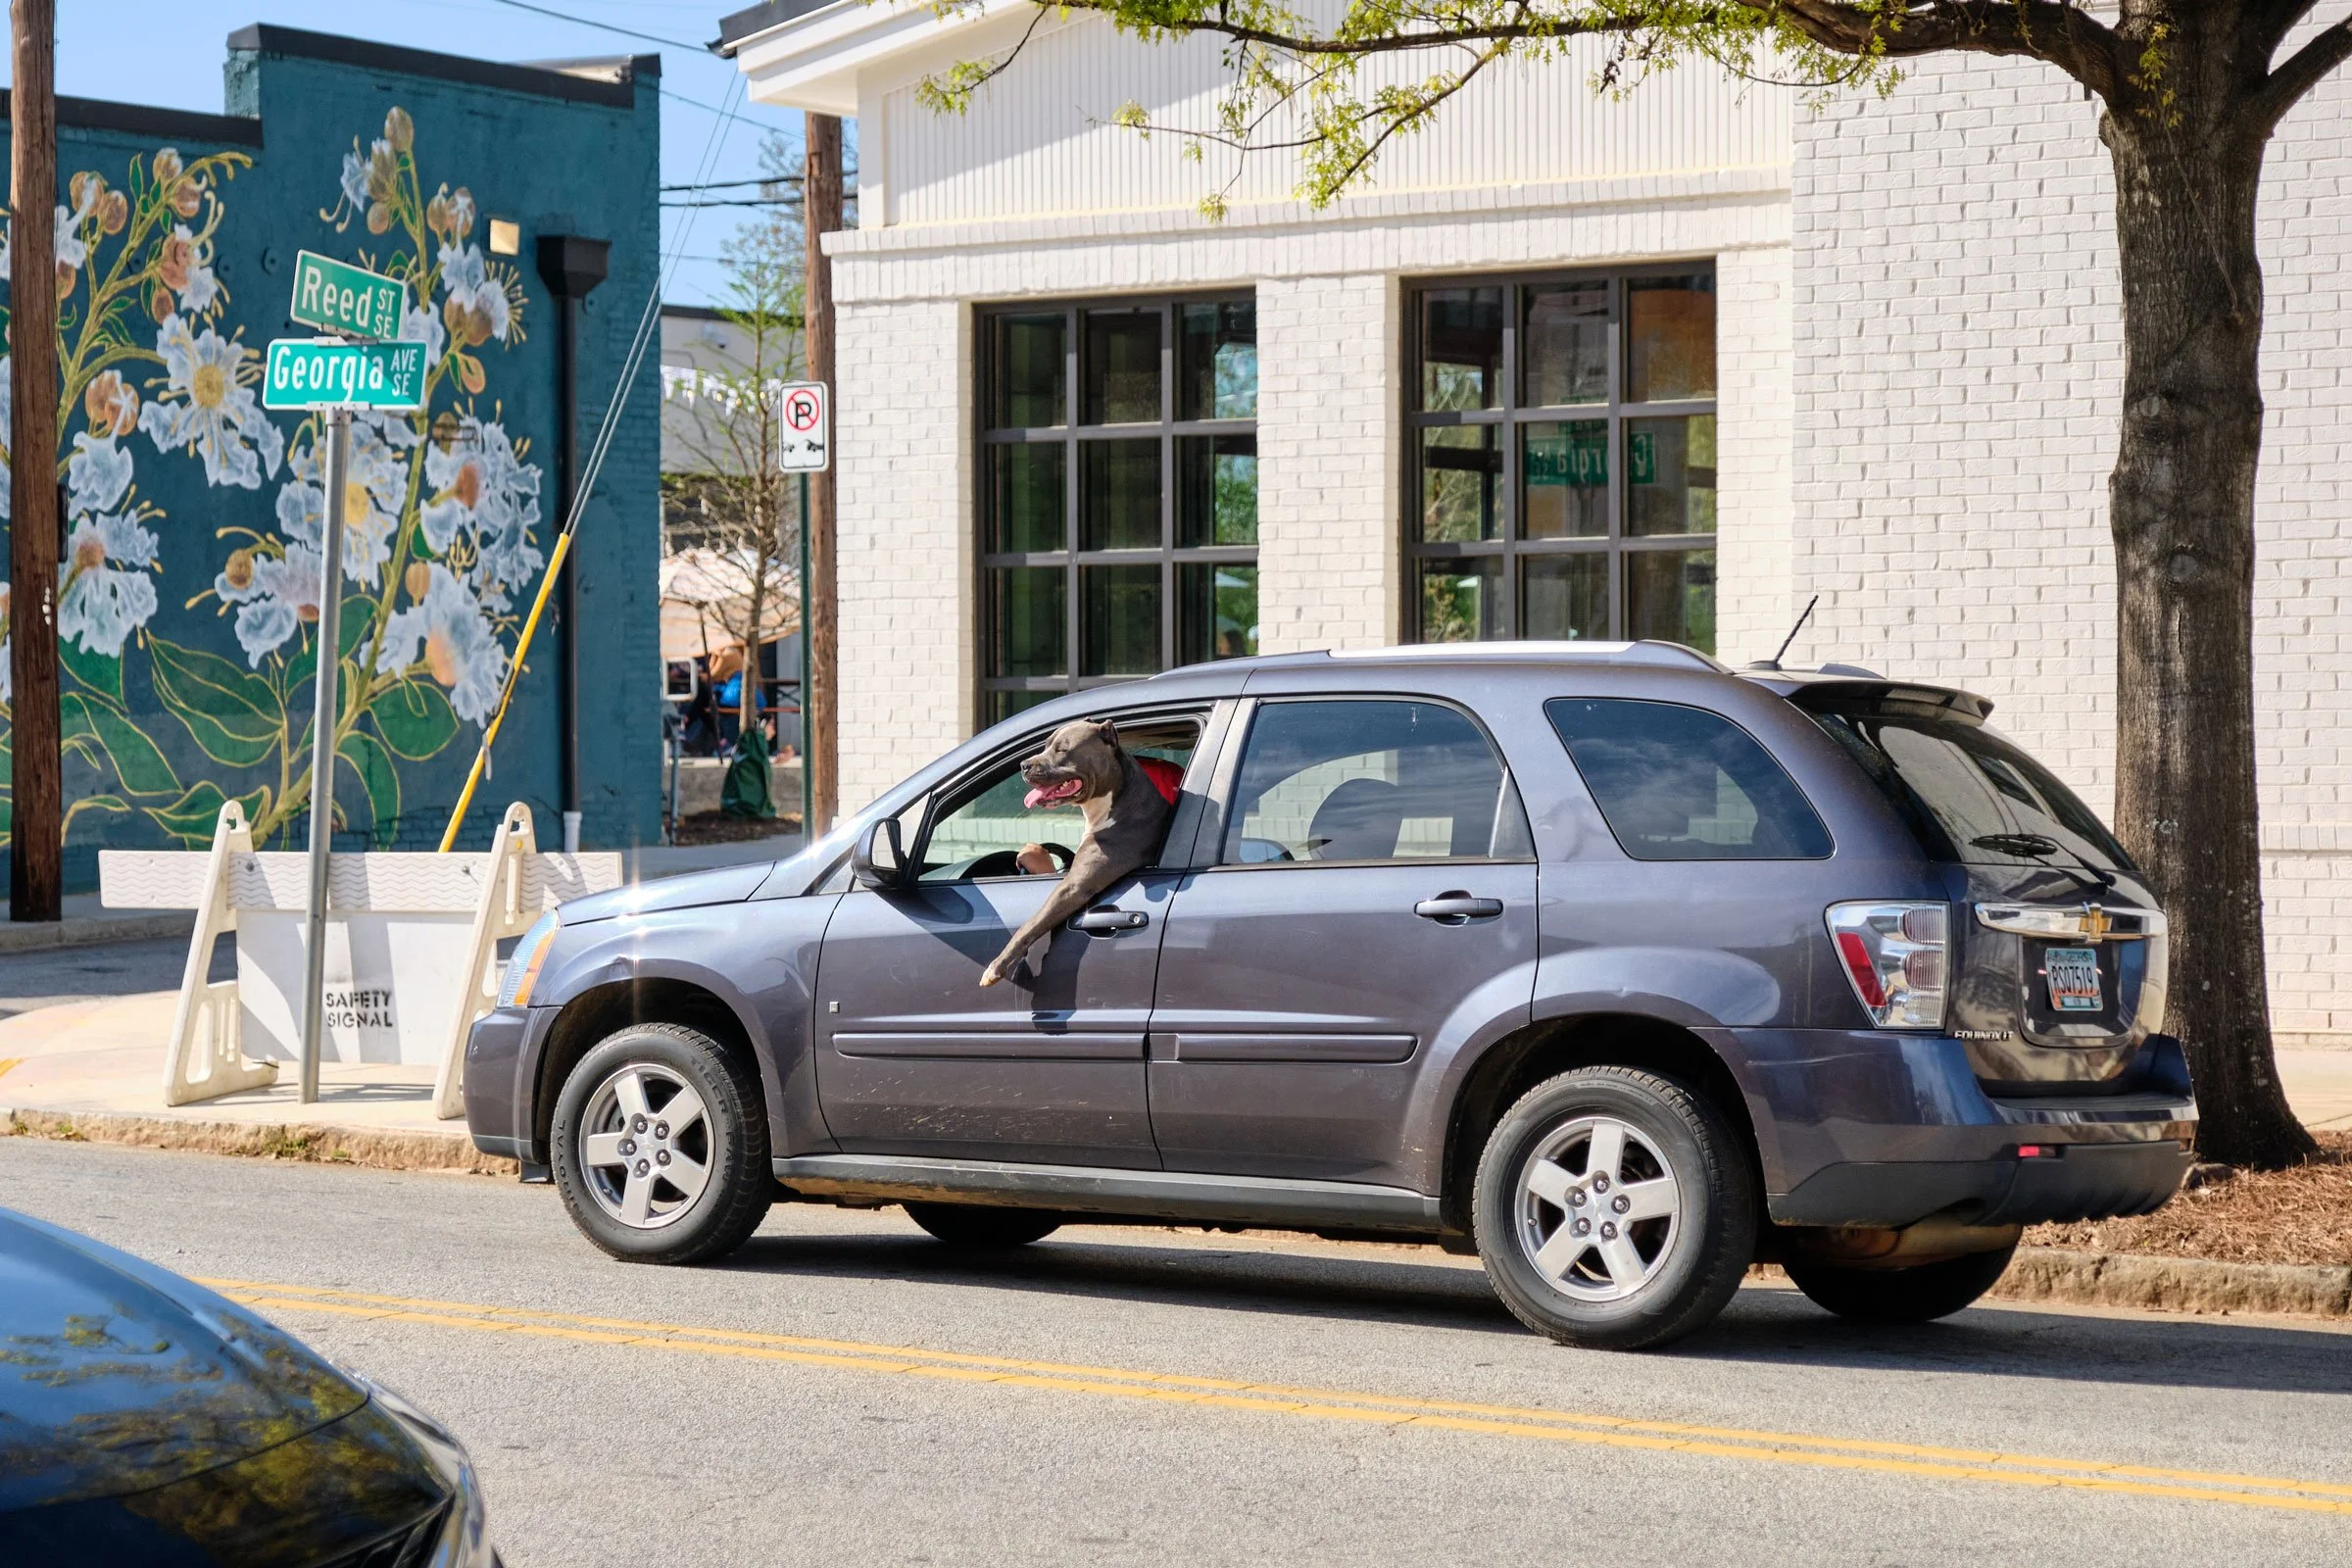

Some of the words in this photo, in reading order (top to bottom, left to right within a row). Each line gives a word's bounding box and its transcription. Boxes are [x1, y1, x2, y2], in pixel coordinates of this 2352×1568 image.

[302, 266, 373, 328] Reed
[377, 288, 395, 313] ST
[373, 315, 393, 339] SE
[273, 345, 384, 403] Georgia
[390, 348, 418, 371] AVE
[392, 373, 411, 396] SE
[326, 990, 392, 1007] SAFETY
[327, 1011, 393, 1028] SIGNAL
